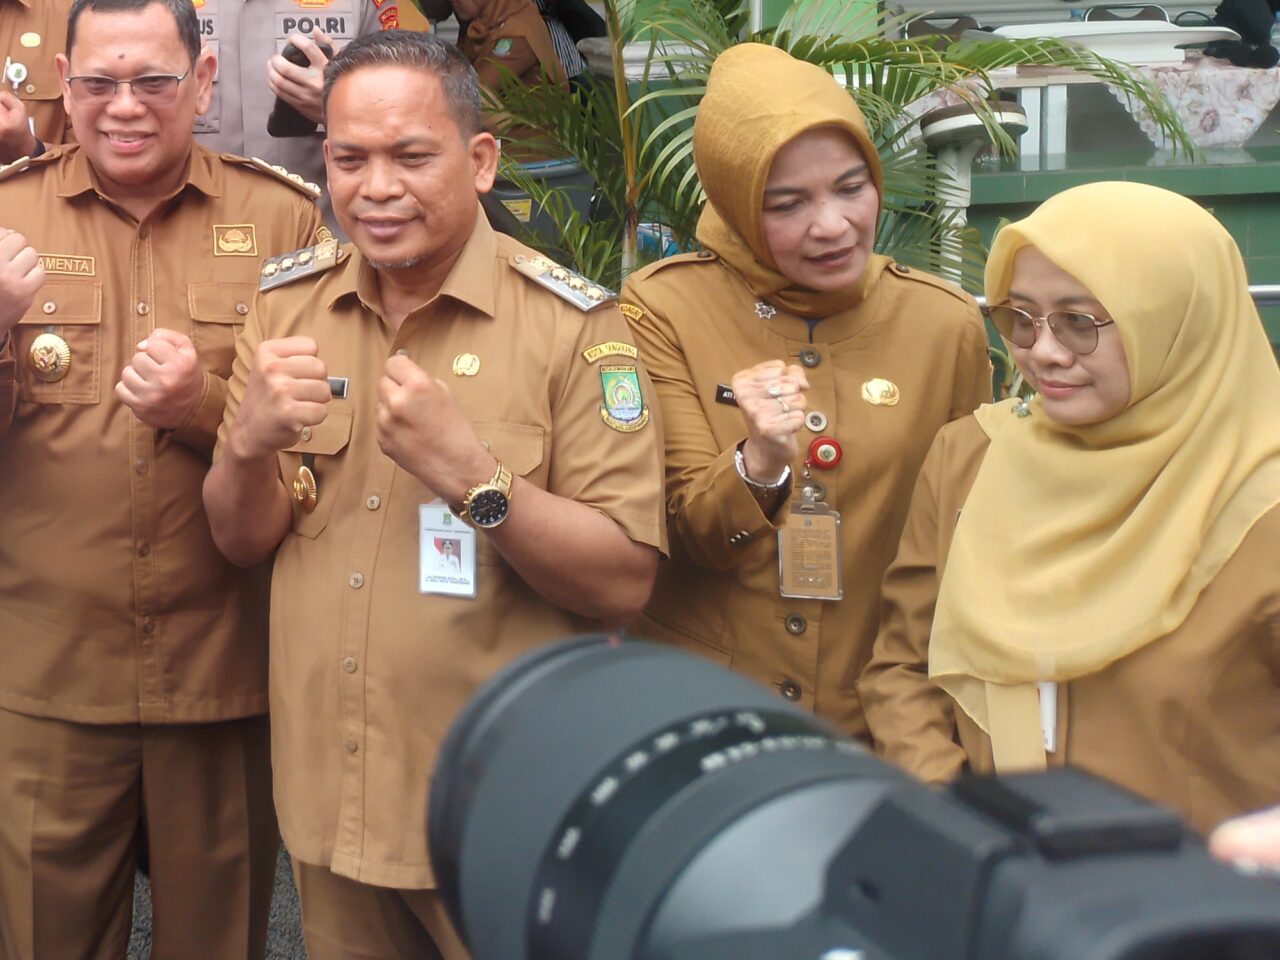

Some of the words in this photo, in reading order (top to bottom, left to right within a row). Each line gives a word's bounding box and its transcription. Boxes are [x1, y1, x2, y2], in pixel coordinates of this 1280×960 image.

[283, 17, 346, 35] POLRI
[586, 348, 603, 359] KOTA
[722, 390, 734, 400] ATI
